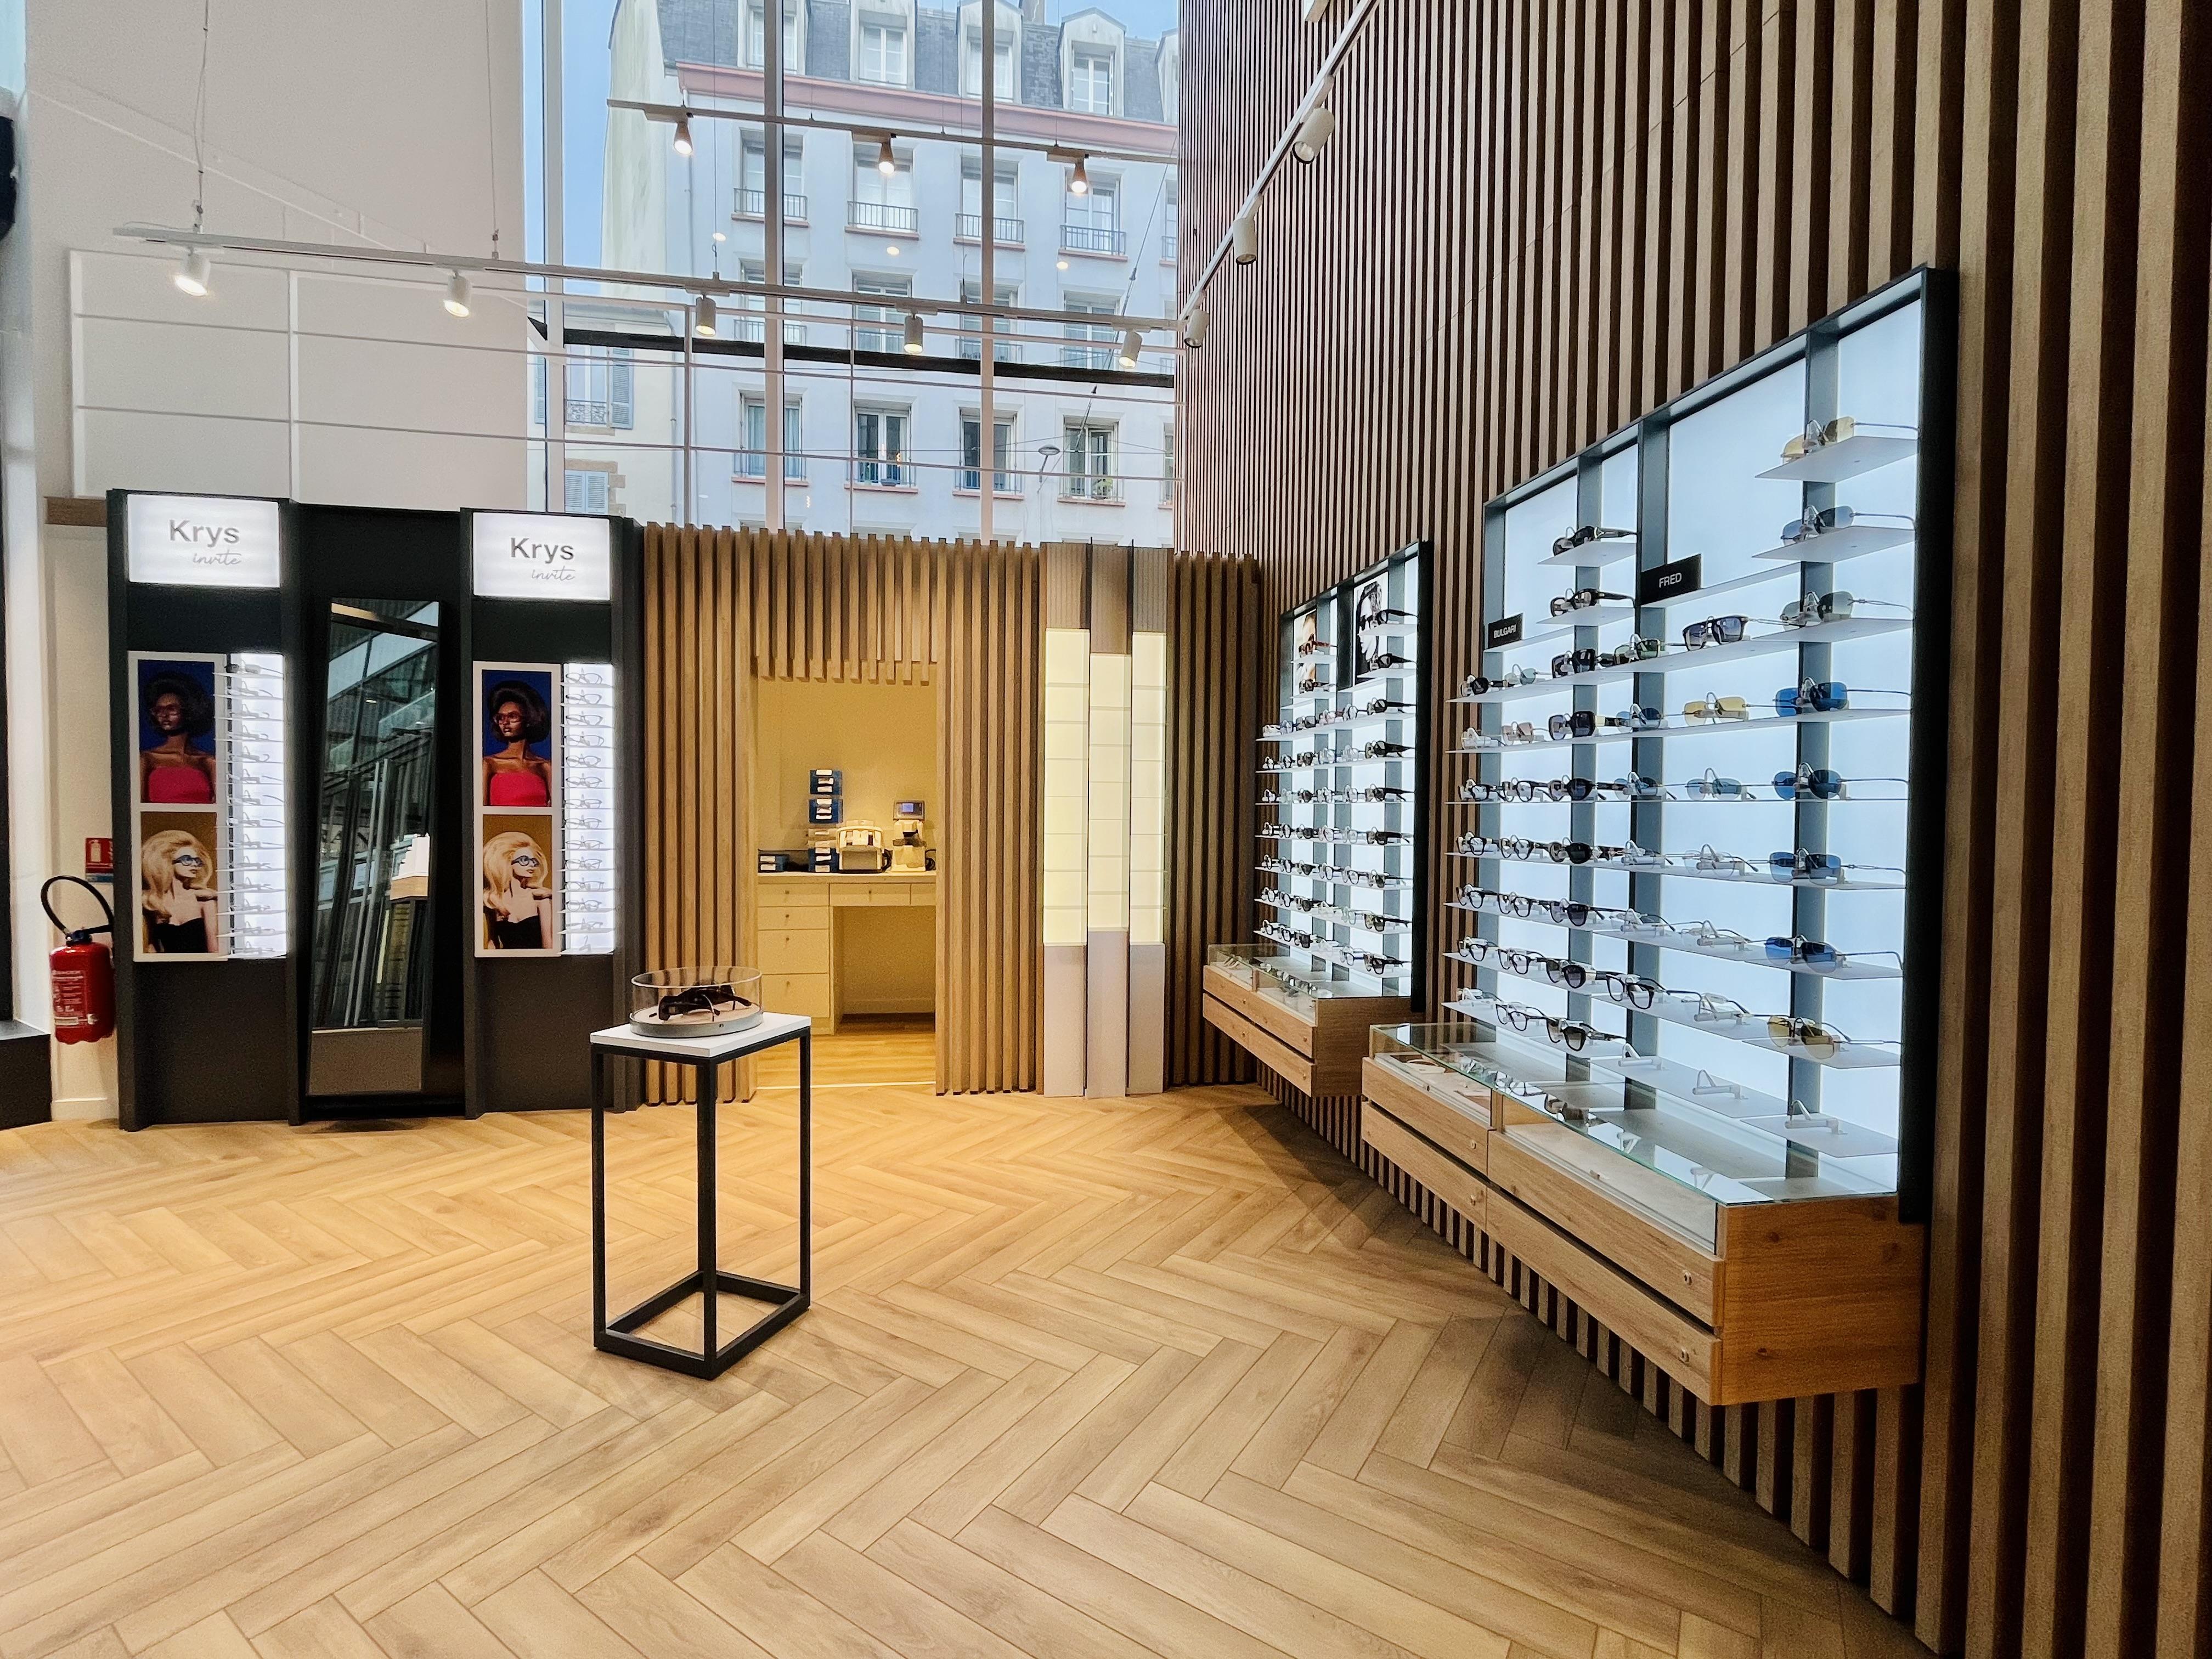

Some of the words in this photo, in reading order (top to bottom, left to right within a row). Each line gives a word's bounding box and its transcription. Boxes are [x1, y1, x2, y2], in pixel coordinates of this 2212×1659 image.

[170, 520, 240, 548] Krys
[193, 549, 241, 565] invite
[511, 537, 574, 564] Krys
[532, 566, 575, 581] invite
[1659, 572, 1682, 588] FRED
[1493, 624, 1516, 639] BULGARI
